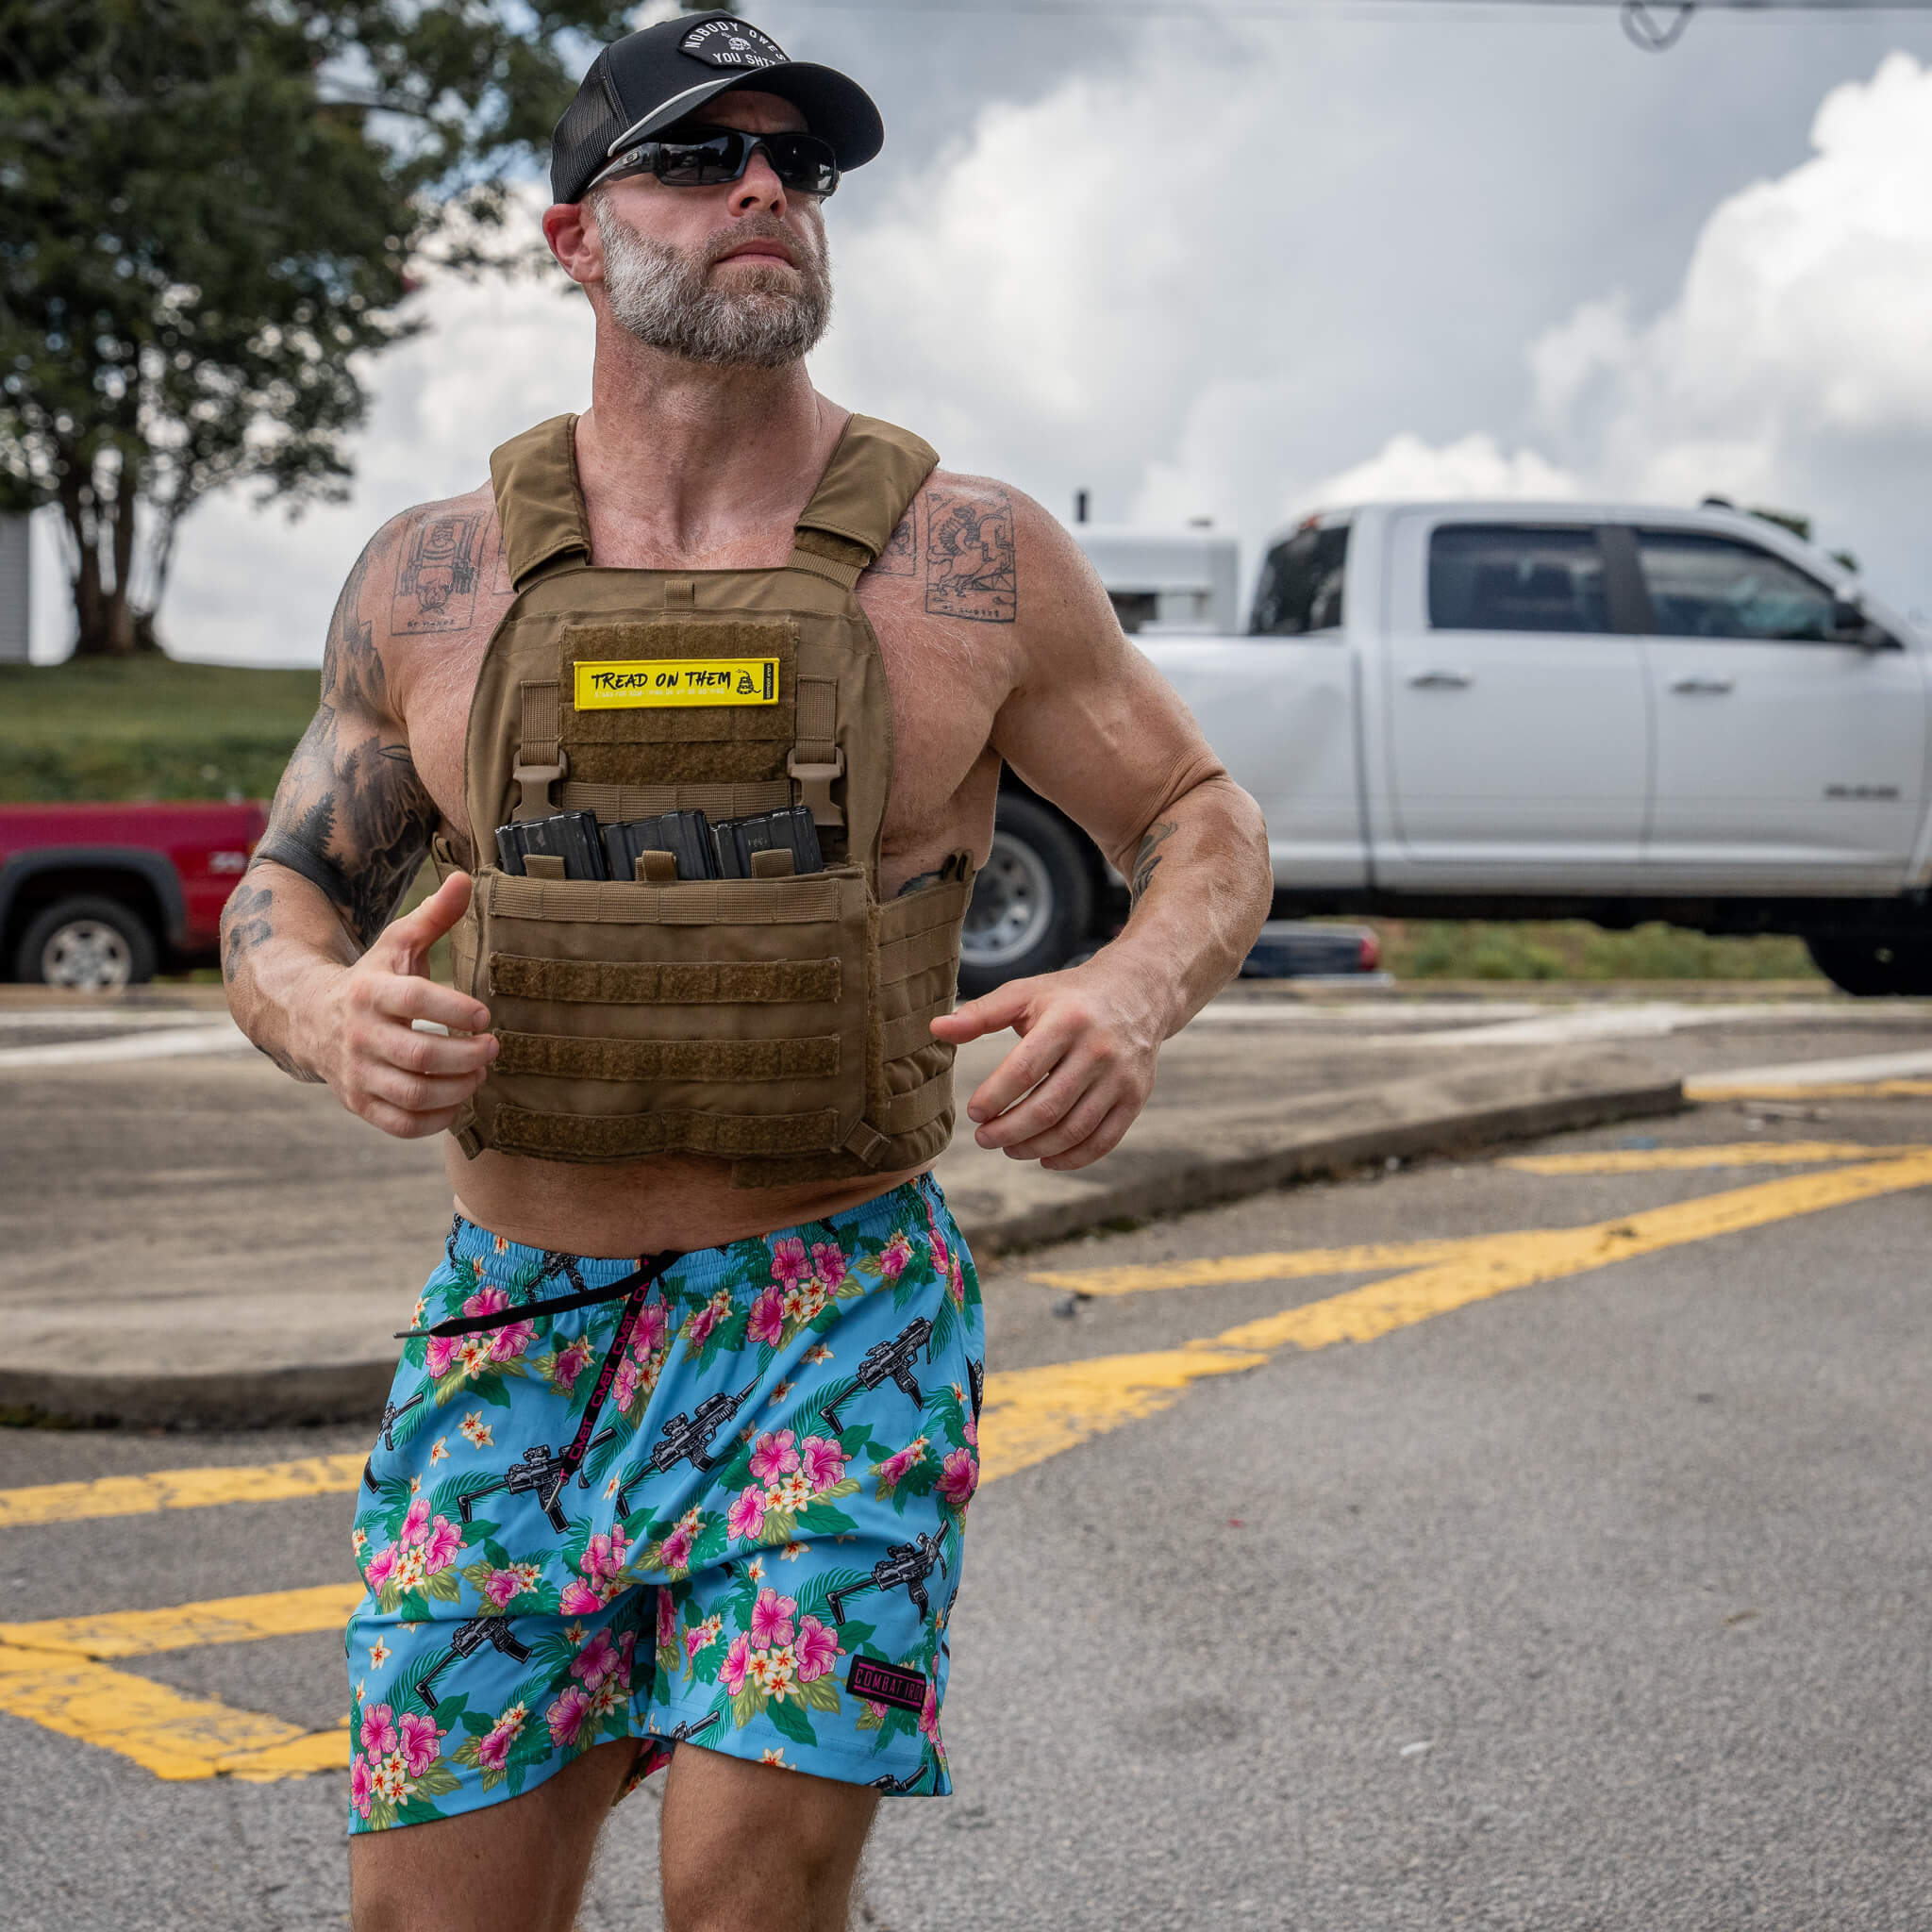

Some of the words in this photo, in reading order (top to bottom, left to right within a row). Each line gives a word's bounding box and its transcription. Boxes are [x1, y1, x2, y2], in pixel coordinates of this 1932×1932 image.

[684, 21, 739, 48] NOBODY
[749, 29, 786, 61] OWES
[712, 52, 741, 63] YOU
[591, 672, 648, 690] TREAD
[656, 672, 679, 688] ON
[685, 670, 731, 689] THEM
[613, 1311, 637, 1356] CMBT
[591, 1361, 615, 1407] CMBT
[569, 1416, 593, 1460] CMBT
[855, 1669, 903, 1695] COMBAT
